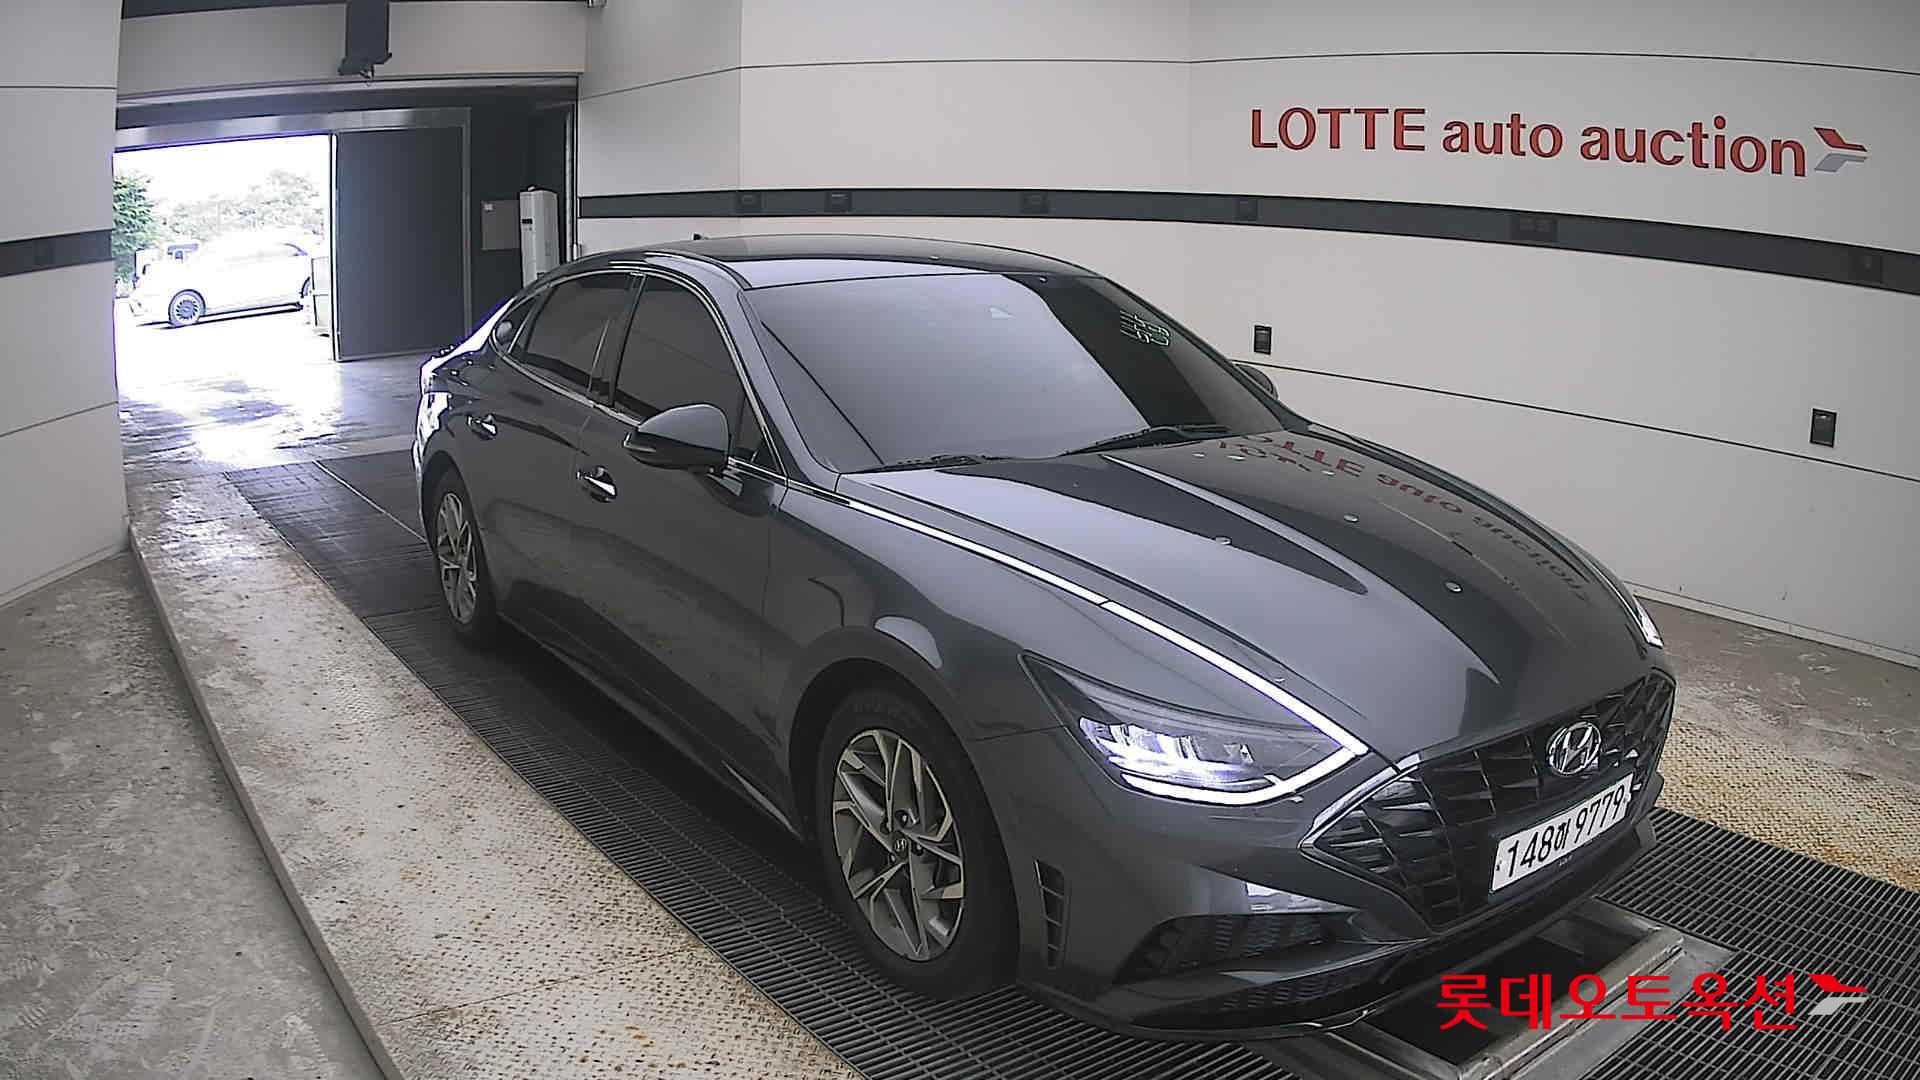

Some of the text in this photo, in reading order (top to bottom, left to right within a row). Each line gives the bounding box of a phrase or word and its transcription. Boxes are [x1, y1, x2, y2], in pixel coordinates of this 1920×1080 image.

[1251, 107, 1807, 177] LOTTE auto auction
[1573, 785, 1625, 845] 9779
